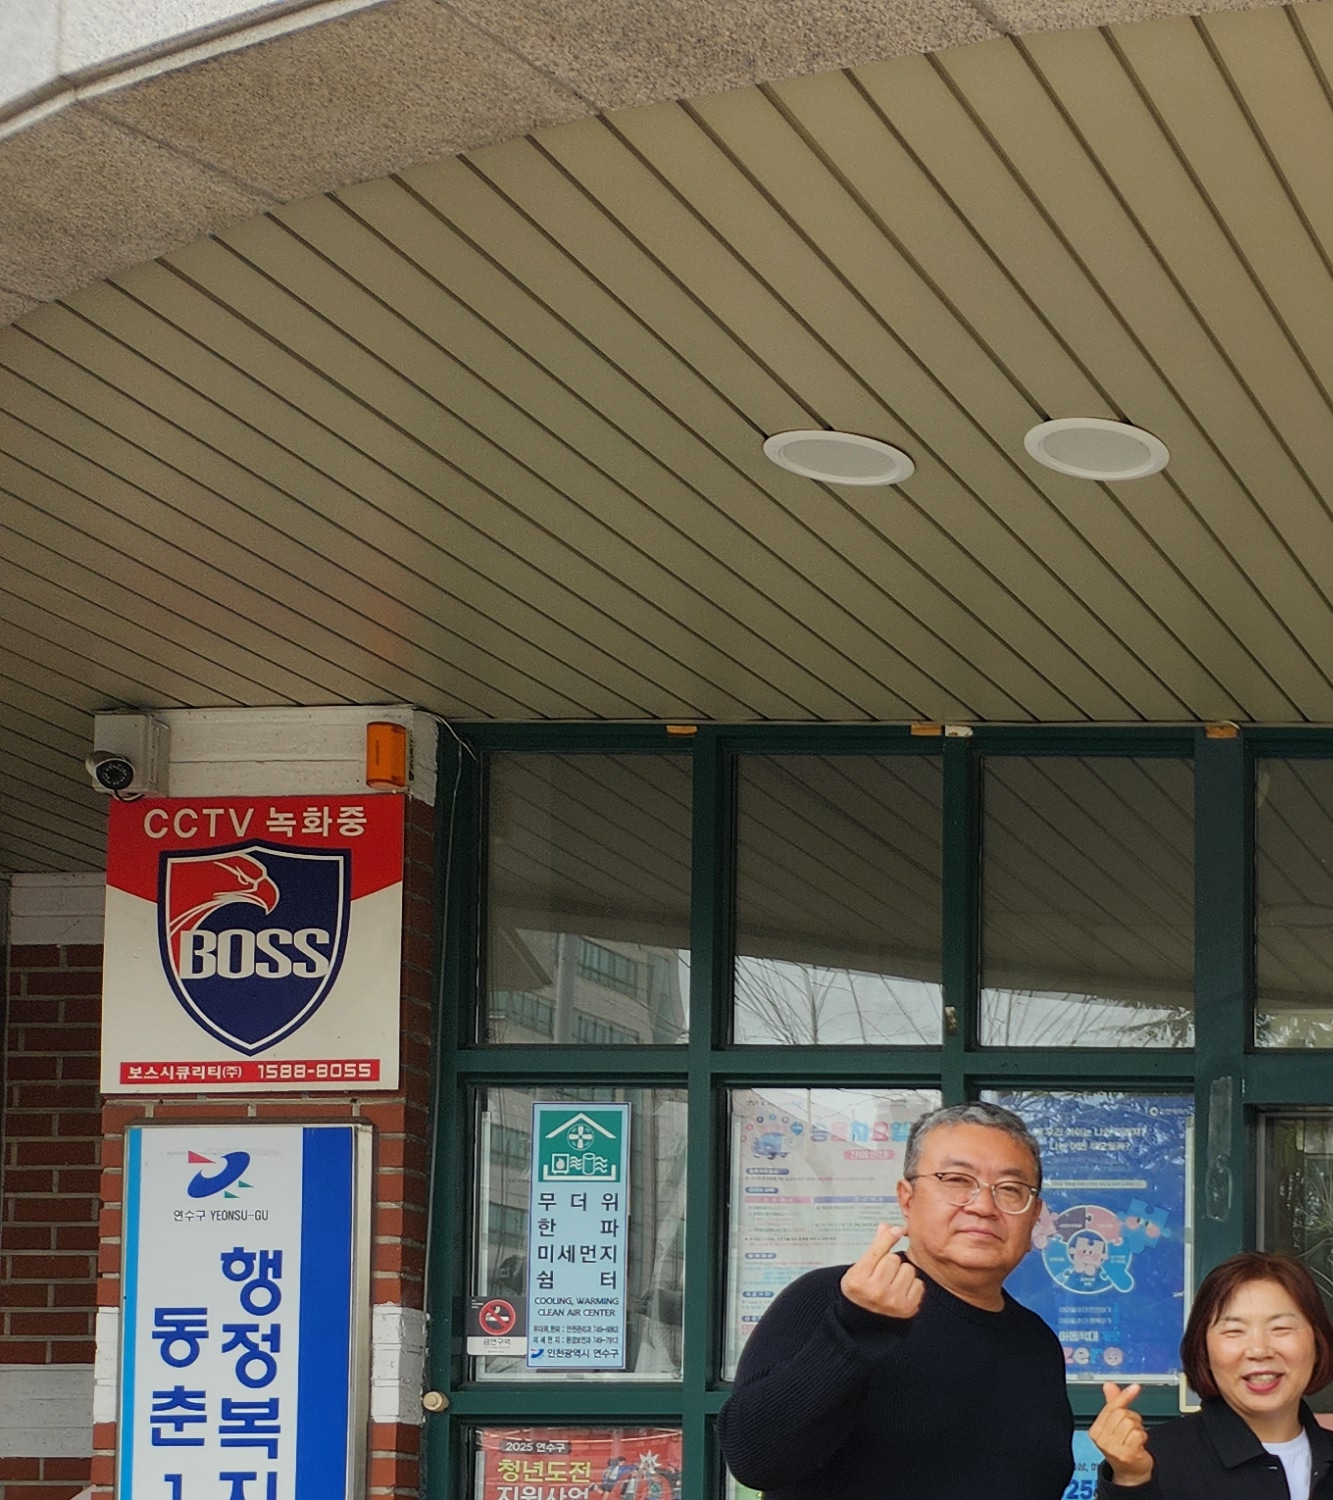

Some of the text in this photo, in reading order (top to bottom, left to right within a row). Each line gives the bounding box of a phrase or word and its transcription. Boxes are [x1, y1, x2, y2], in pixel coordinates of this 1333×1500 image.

[144, 806, 367, 838] CCTV 녹화중
[179, 928, 330, 979] BOSS
[127, 1063, 372, 1080] 보스시큐리티(주) 1588-8055
[174, 1210, 269, 1222] 연수구 YEONSU-GU
[538, 1245, 617, 1264] 미세먼지
[577, 1297, 619, 1305] WARMING
[547, 1348, 619, 1358] 인천광역시 연수구
[505, 1441, 566, 1453] 2025 연수구
[497, 1459, 591, 1483] 청년도전
